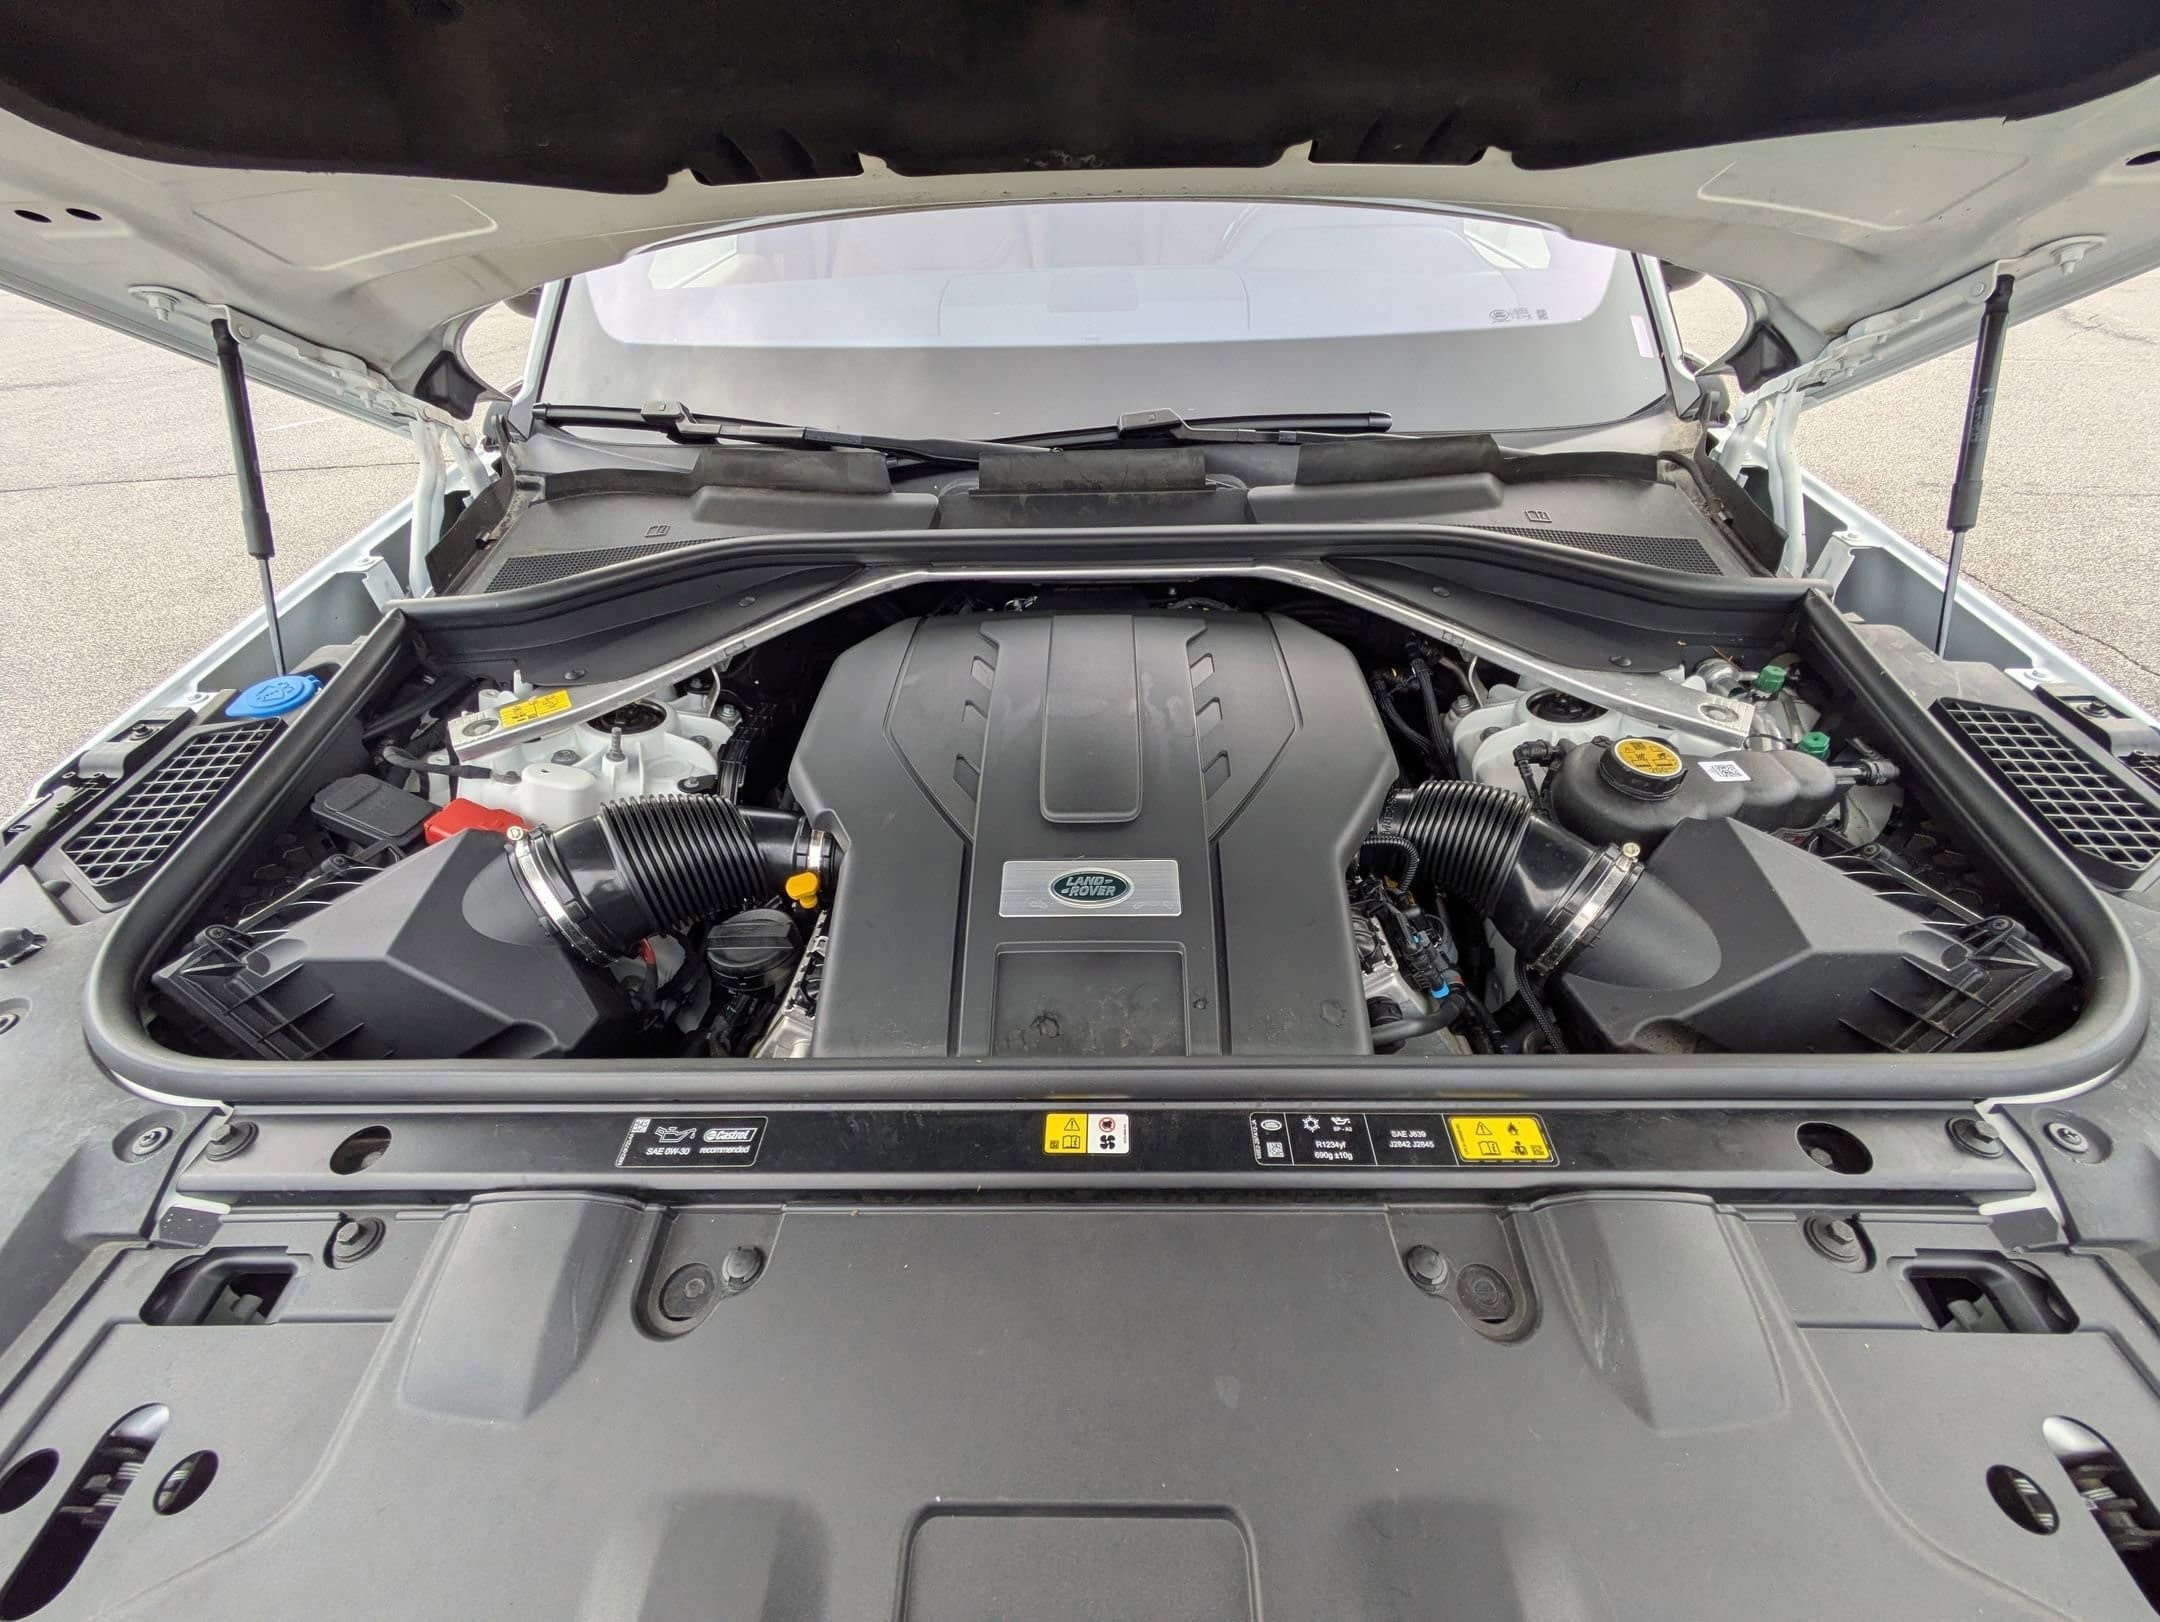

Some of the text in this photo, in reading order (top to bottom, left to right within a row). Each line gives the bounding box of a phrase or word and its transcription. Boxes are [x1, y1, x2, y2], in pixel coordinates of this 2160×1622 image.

[715, 1130, 750, 1140] Castrol
[645, 1147, 664, 1155] SAE
[699, 1145, 751, 1154] recommended
